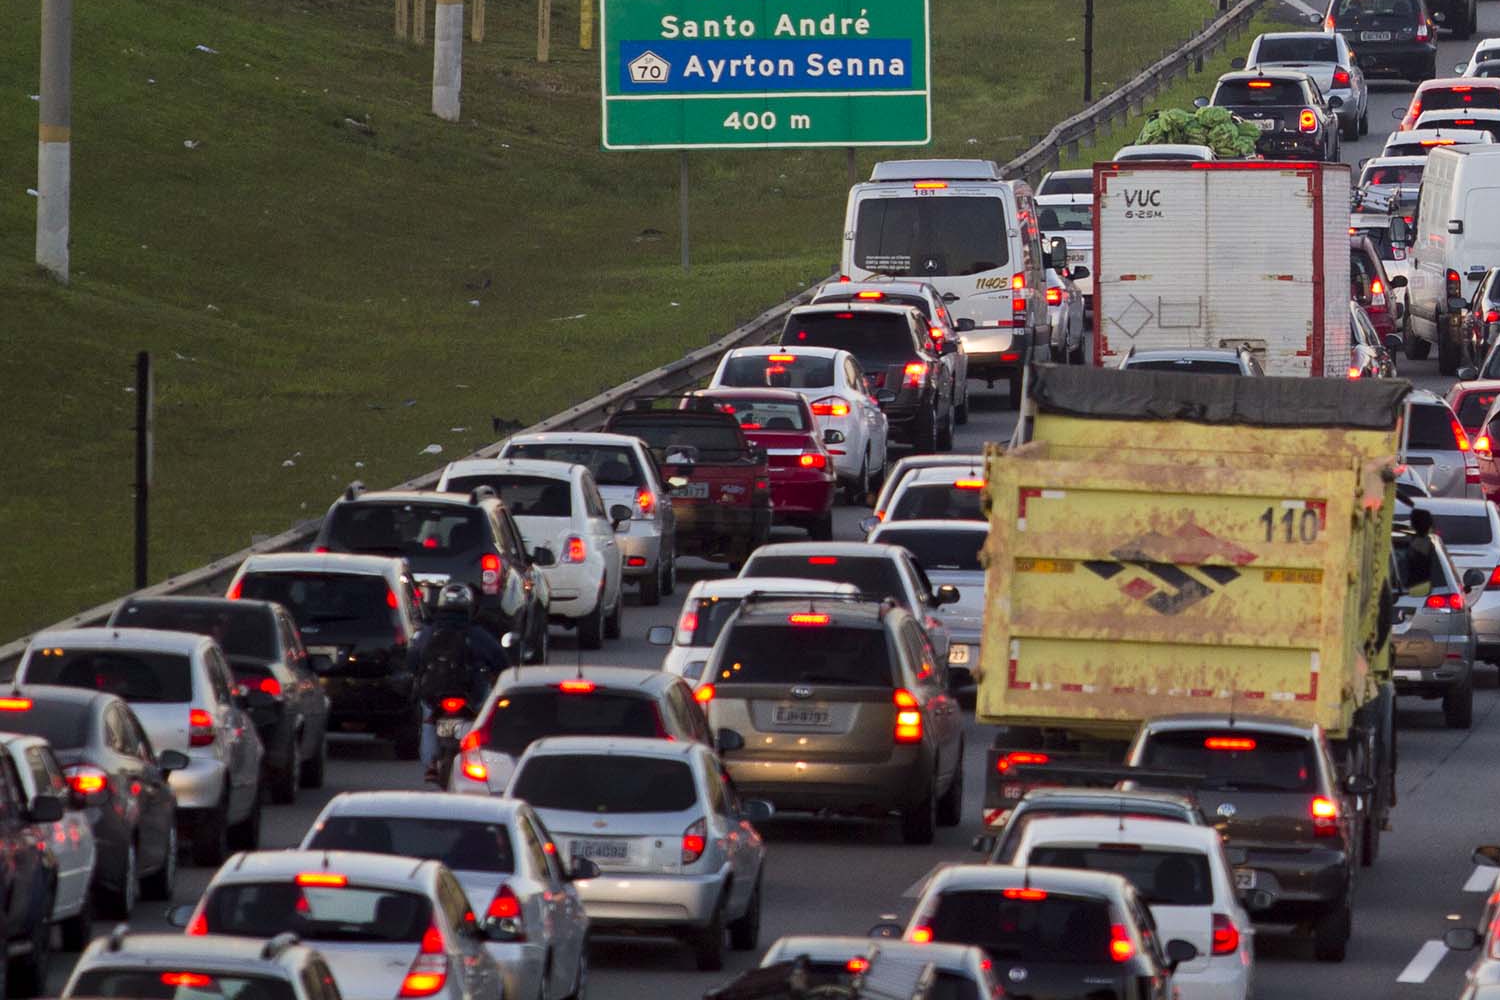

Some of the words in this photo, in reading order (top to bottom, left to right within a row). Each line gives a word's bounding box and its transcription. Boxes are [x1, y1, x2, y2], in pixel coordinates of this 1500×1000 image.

[660, 15, 755, 38] Santo
[774, 9, 870, 35] André
[637, 66, 662, 79] 70
[683, 54, 795, 83] Ayrton
[806, 52, 904, 77] Senna
[723, 112, 777, 130] 400
[790, 114, 811, 130] m
[1124, 188, 1161, 208] VUC
[975, 276, 1008, 289] 11405
[1260, 506, 1318, 544] 110
